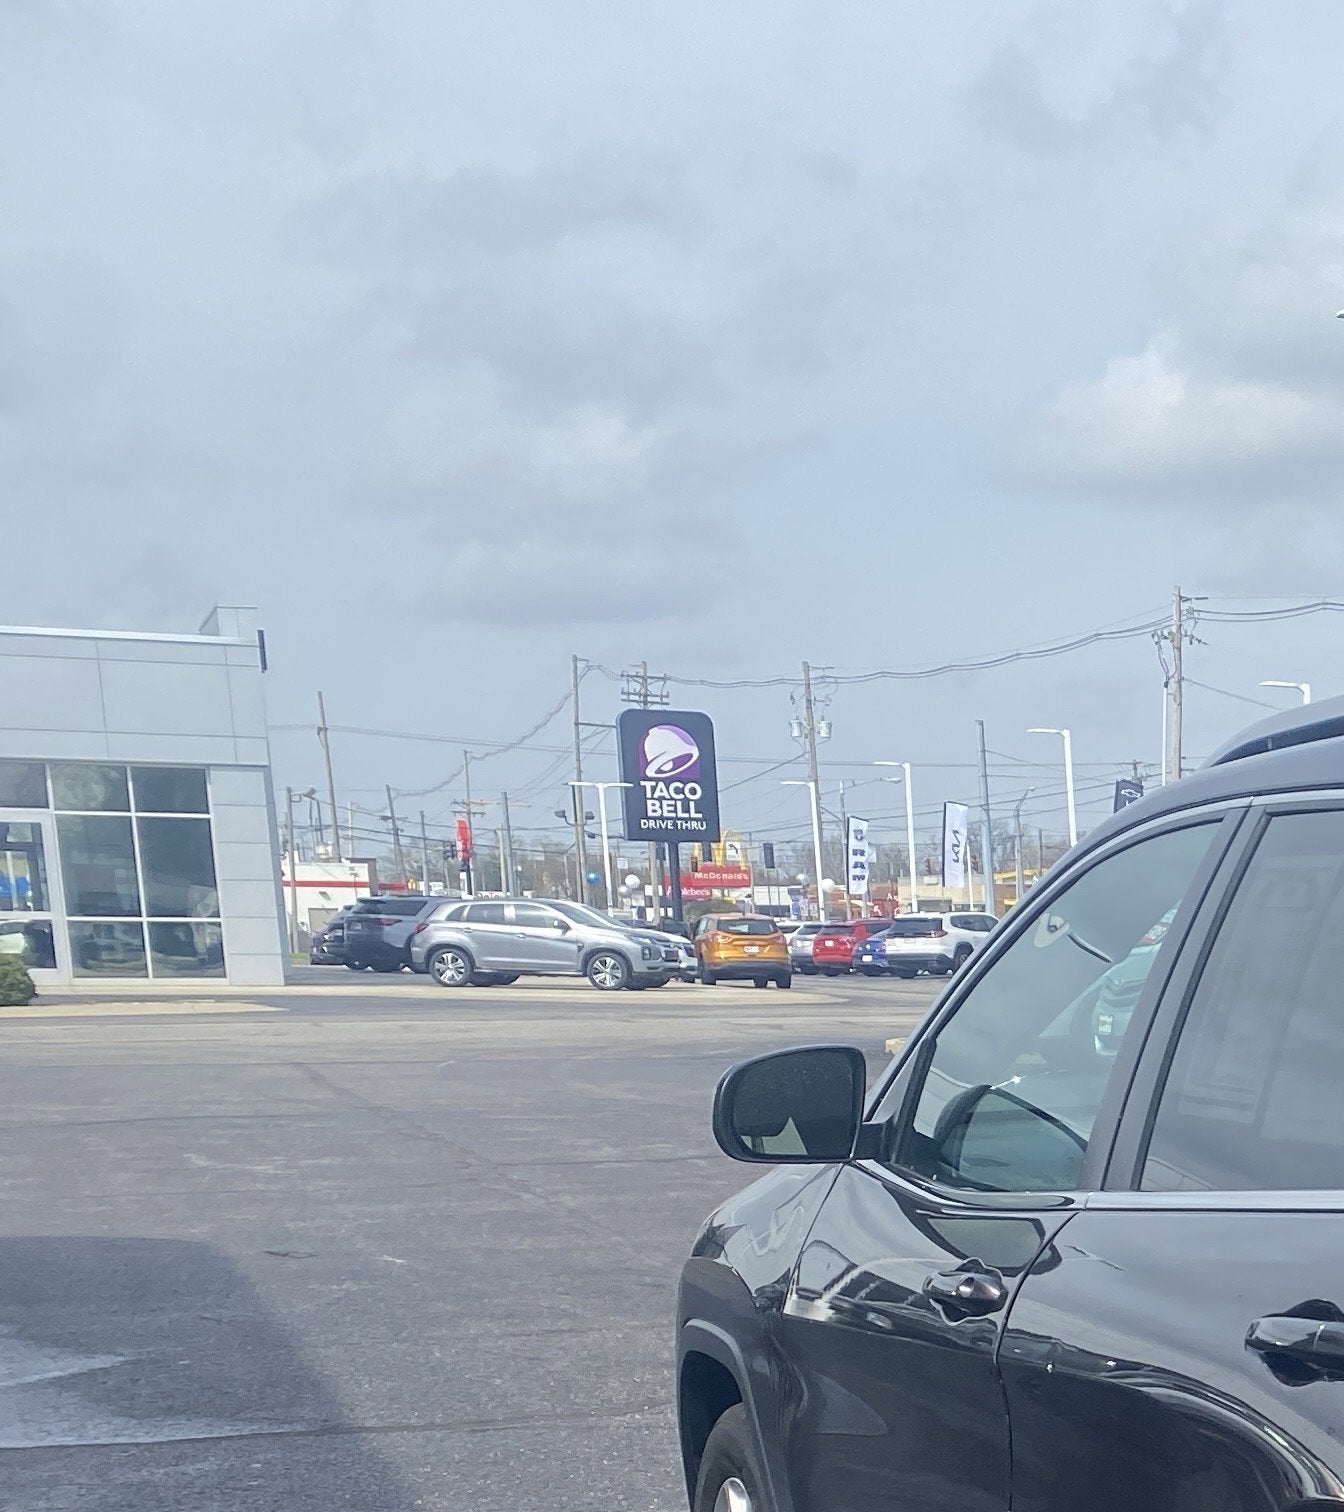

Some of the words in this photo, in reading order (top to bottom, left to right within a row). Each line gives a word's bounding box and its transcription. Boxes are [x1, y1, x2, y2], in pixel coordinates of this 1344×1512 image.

[640, 780, 702, 800] TACO
[646, 799, 703, 818] BELL
[640, 819, 673, 829] DRIVE
[676, 820, 707, 830] THRU
